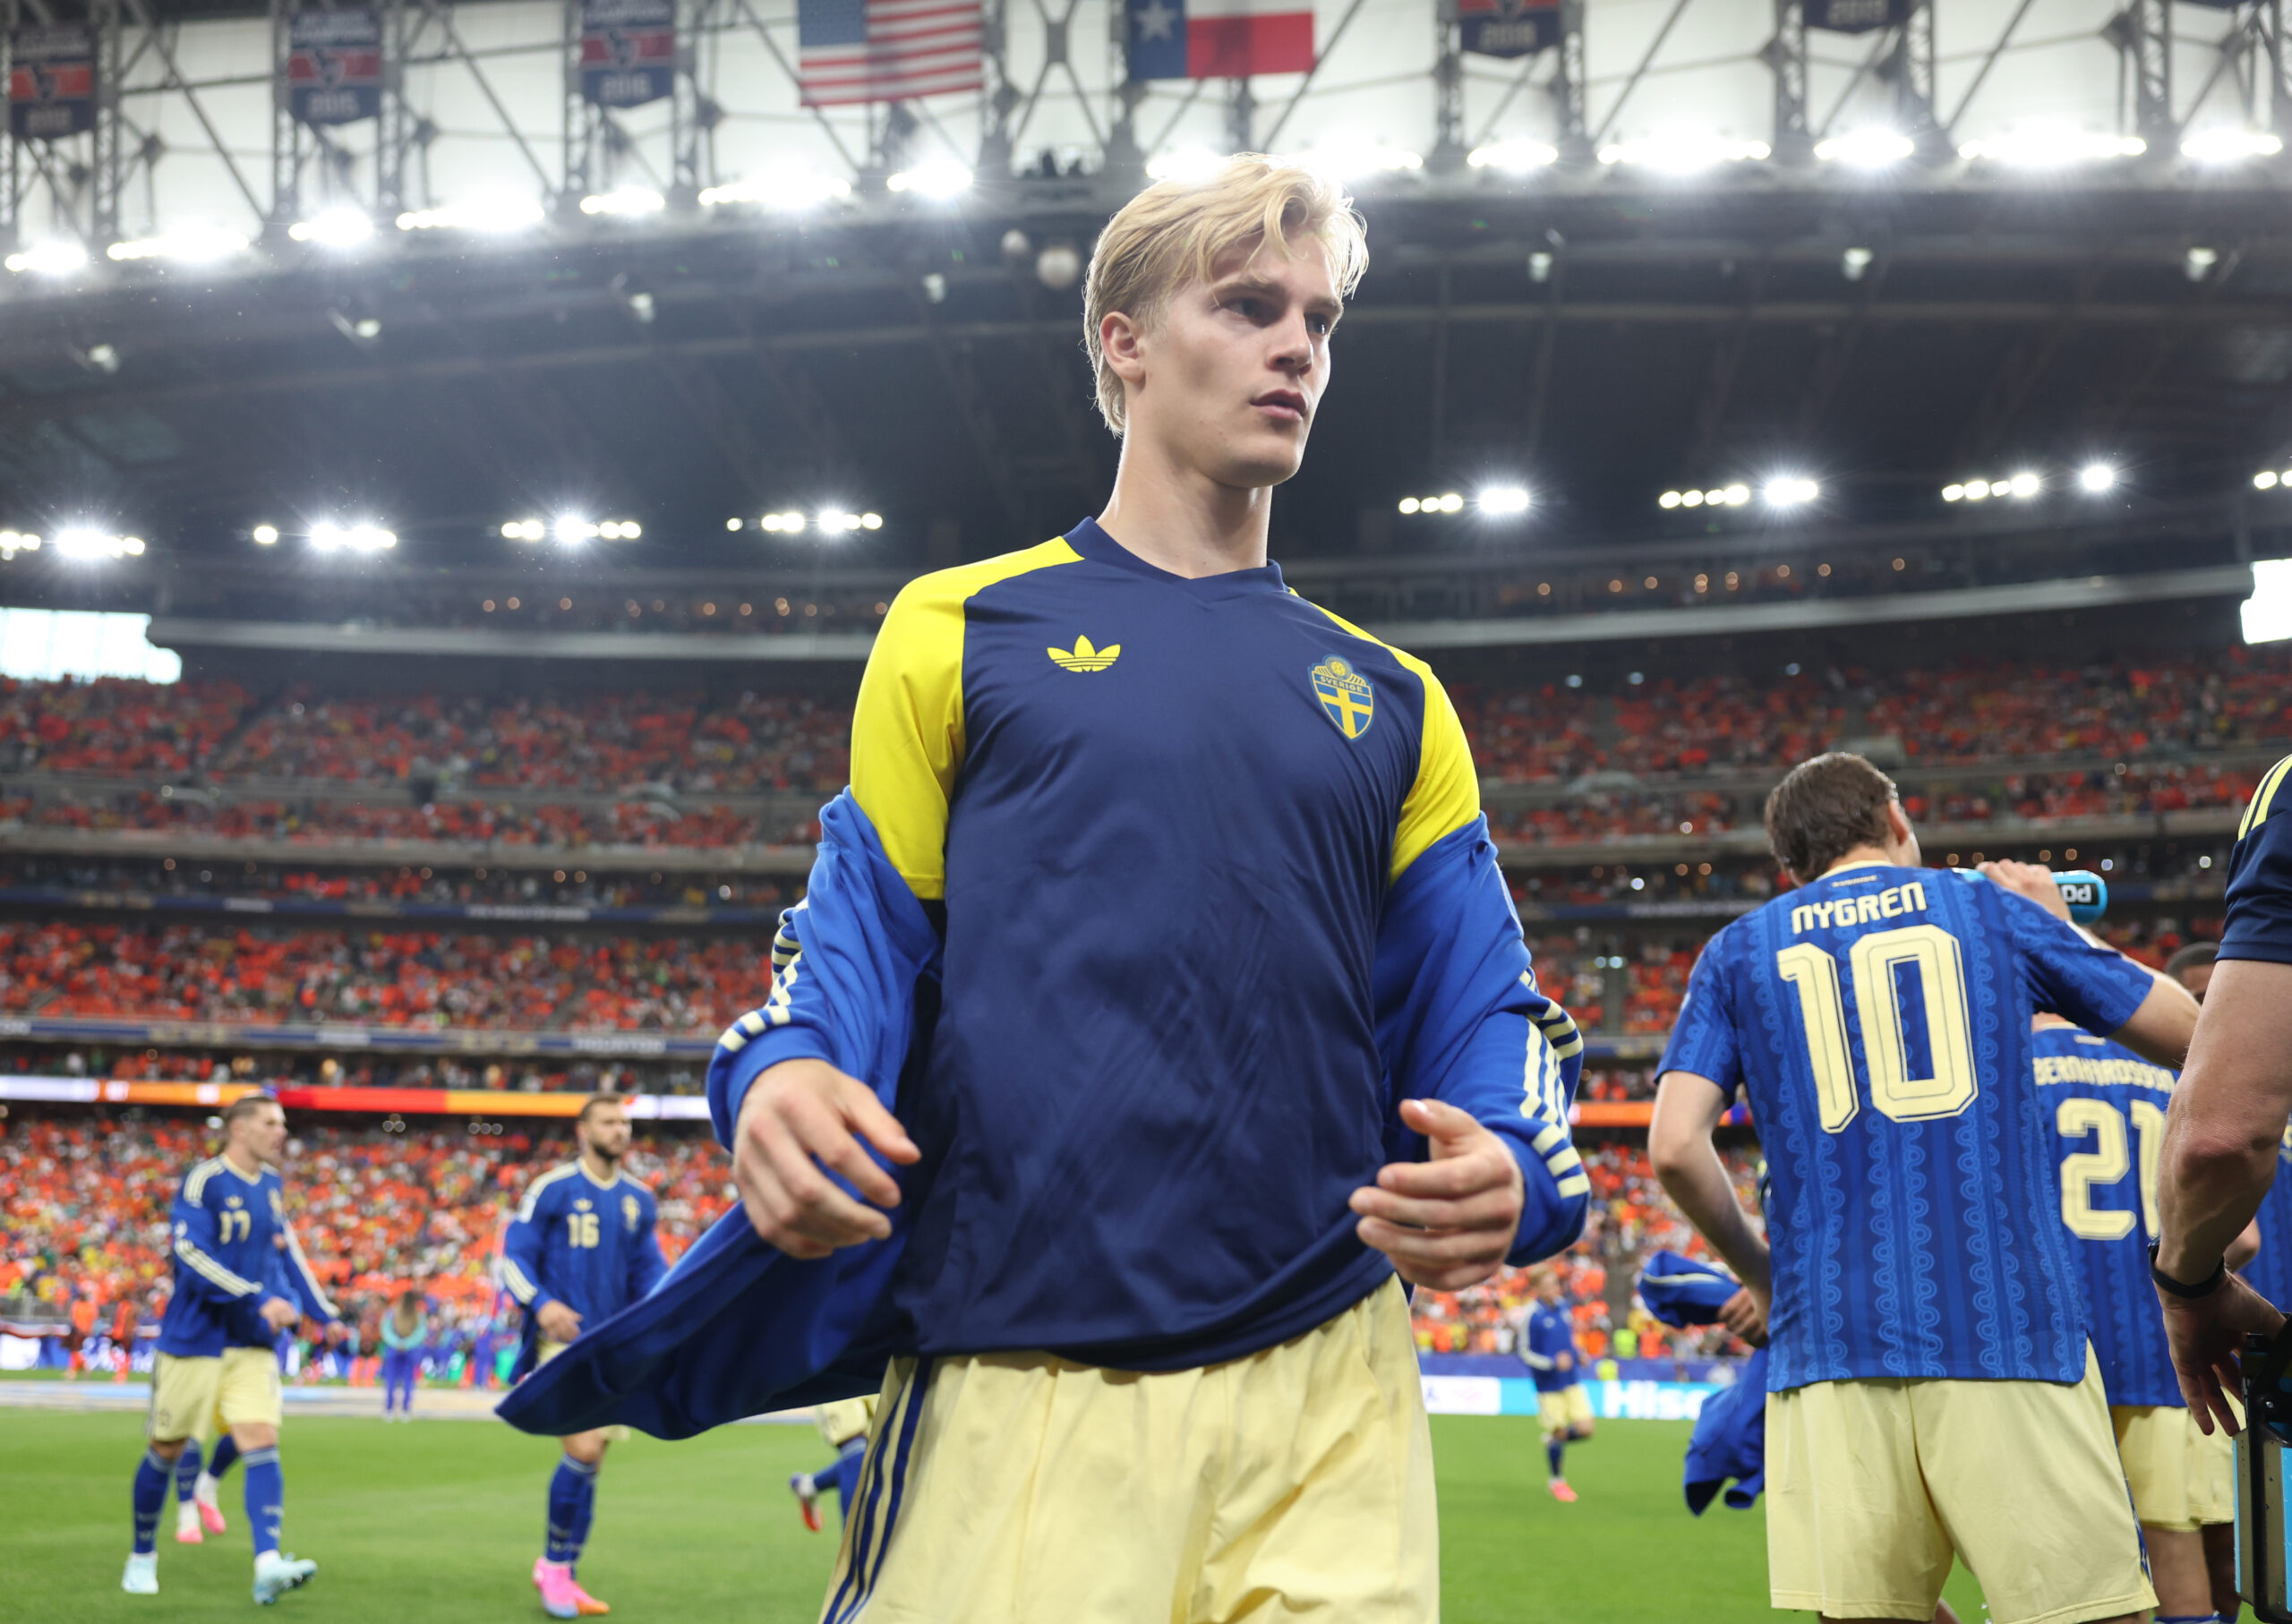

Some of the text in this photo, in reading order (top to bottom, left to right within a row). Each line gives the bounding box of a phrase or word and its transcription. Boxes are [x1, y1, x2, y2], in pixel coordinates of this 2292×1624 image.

[1320, 676, 1363, 693] SVERIGE
[1792, 882, 1927, 935] NYGREN
[1776, 923, 1980, 1134] 10
[2057, 1098, 2166, 1241] 21
[219, 1209, 251, 1244] 17
[567, 1212, 600, 1249] 16
